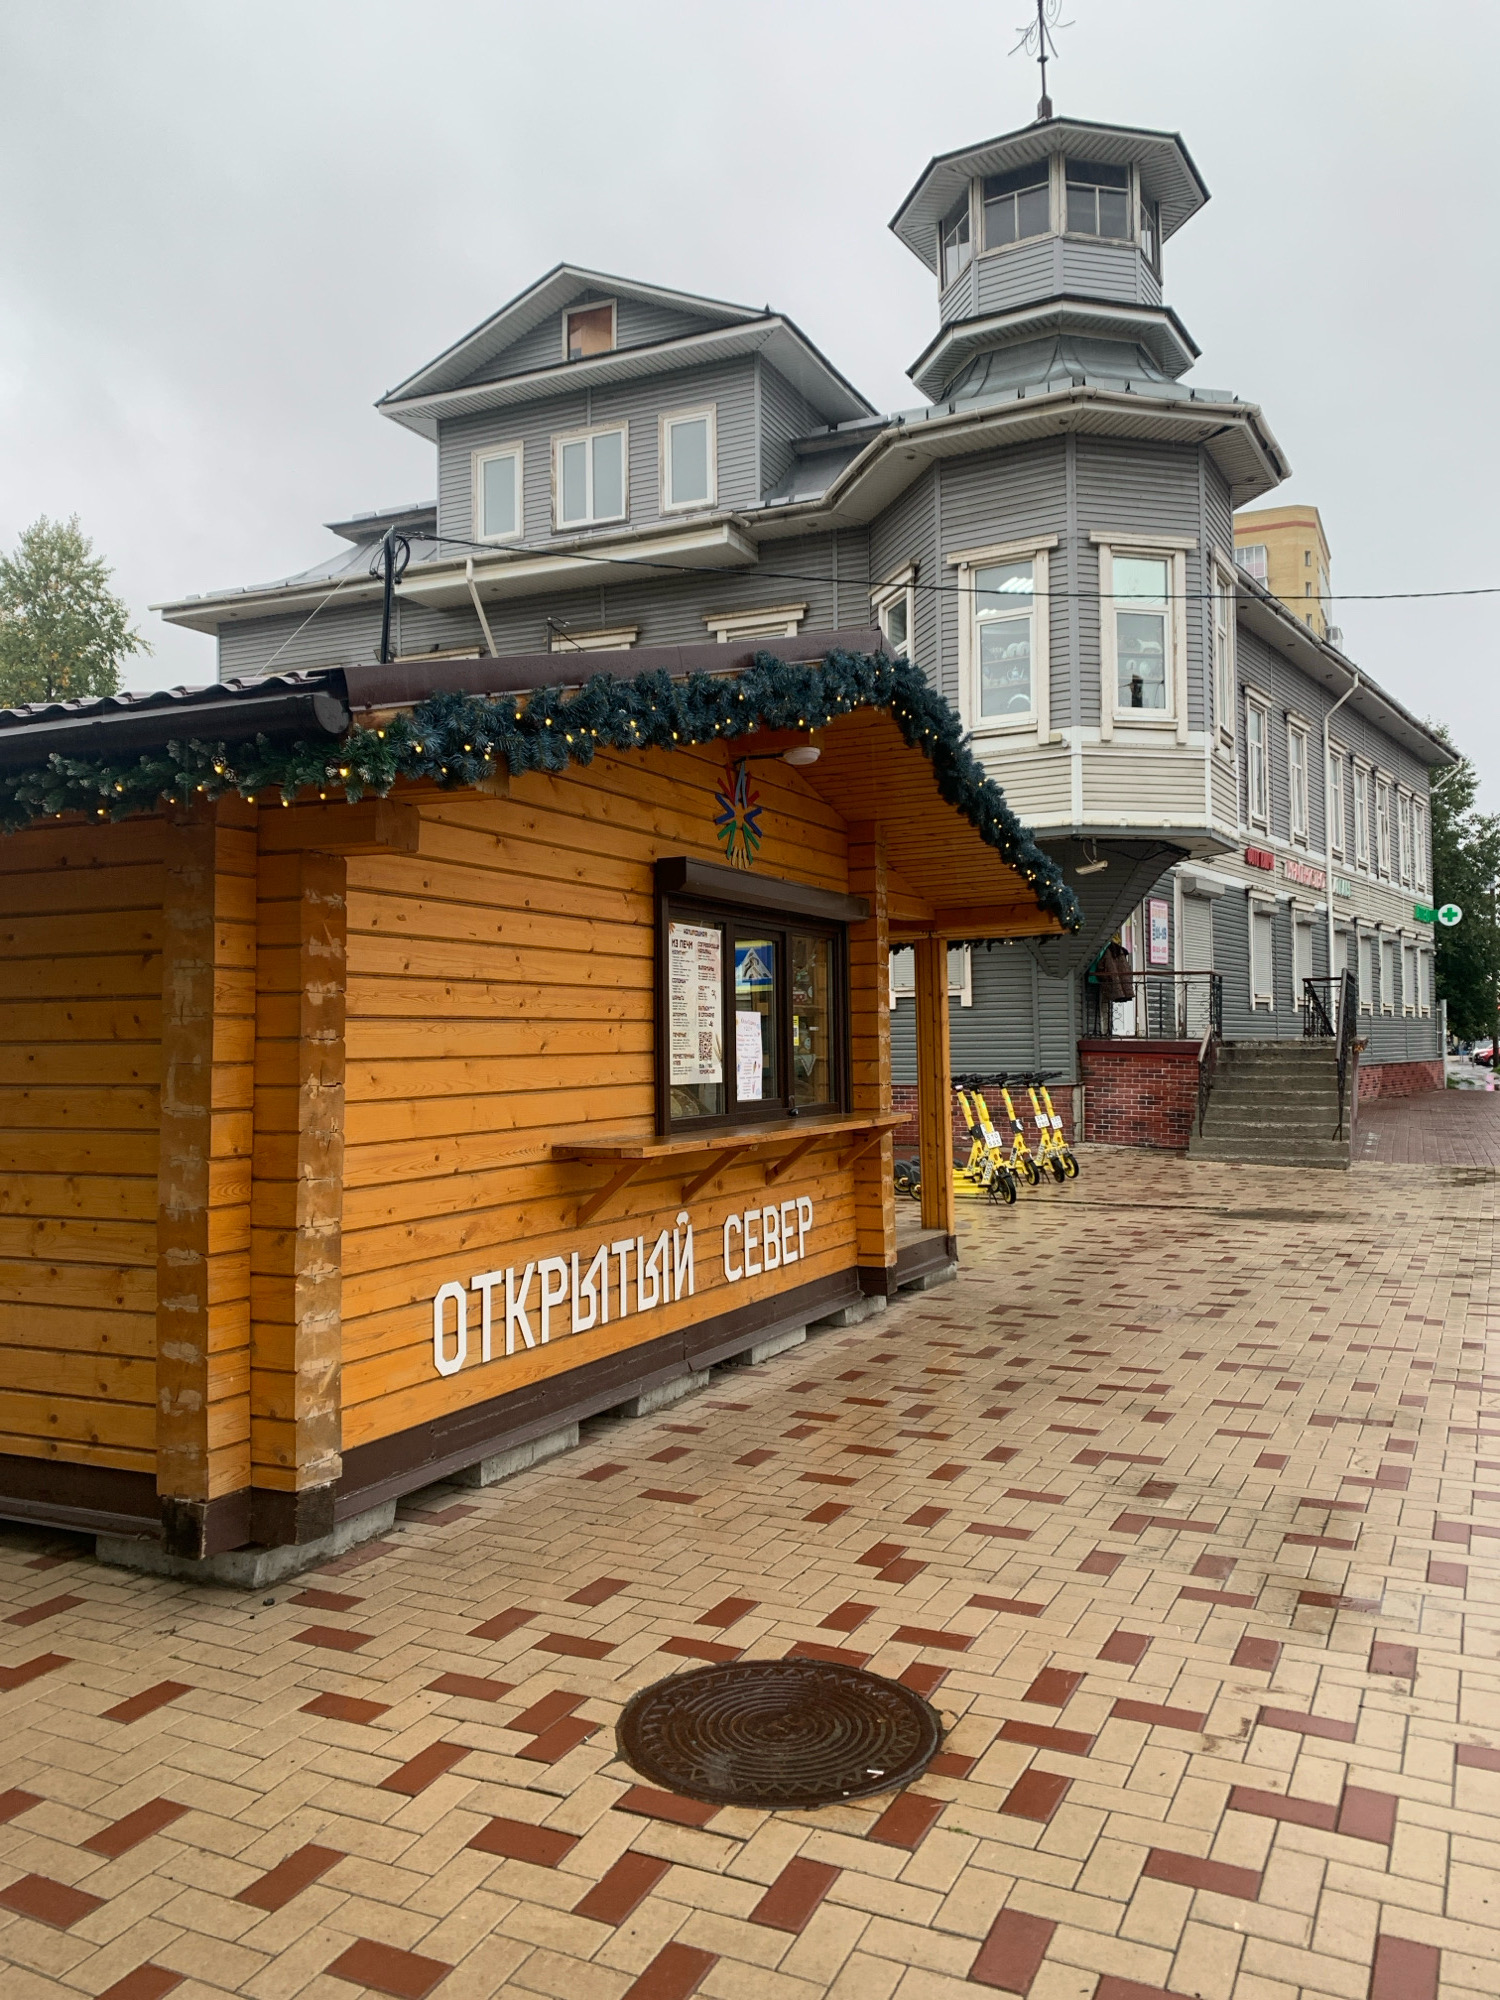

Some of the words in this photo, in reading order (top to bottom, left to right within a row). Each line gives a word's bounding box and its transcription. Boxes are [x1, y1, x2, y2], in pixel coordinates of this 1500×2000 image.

[671, 938, 679, 948] ИЗ
[679, 939, 693, 950] ПЕЧИ
[433, 1210, 694, 1377] ОТКРЫТЫЙ
[723, 1195, 813, 1283] СЕВЕР
